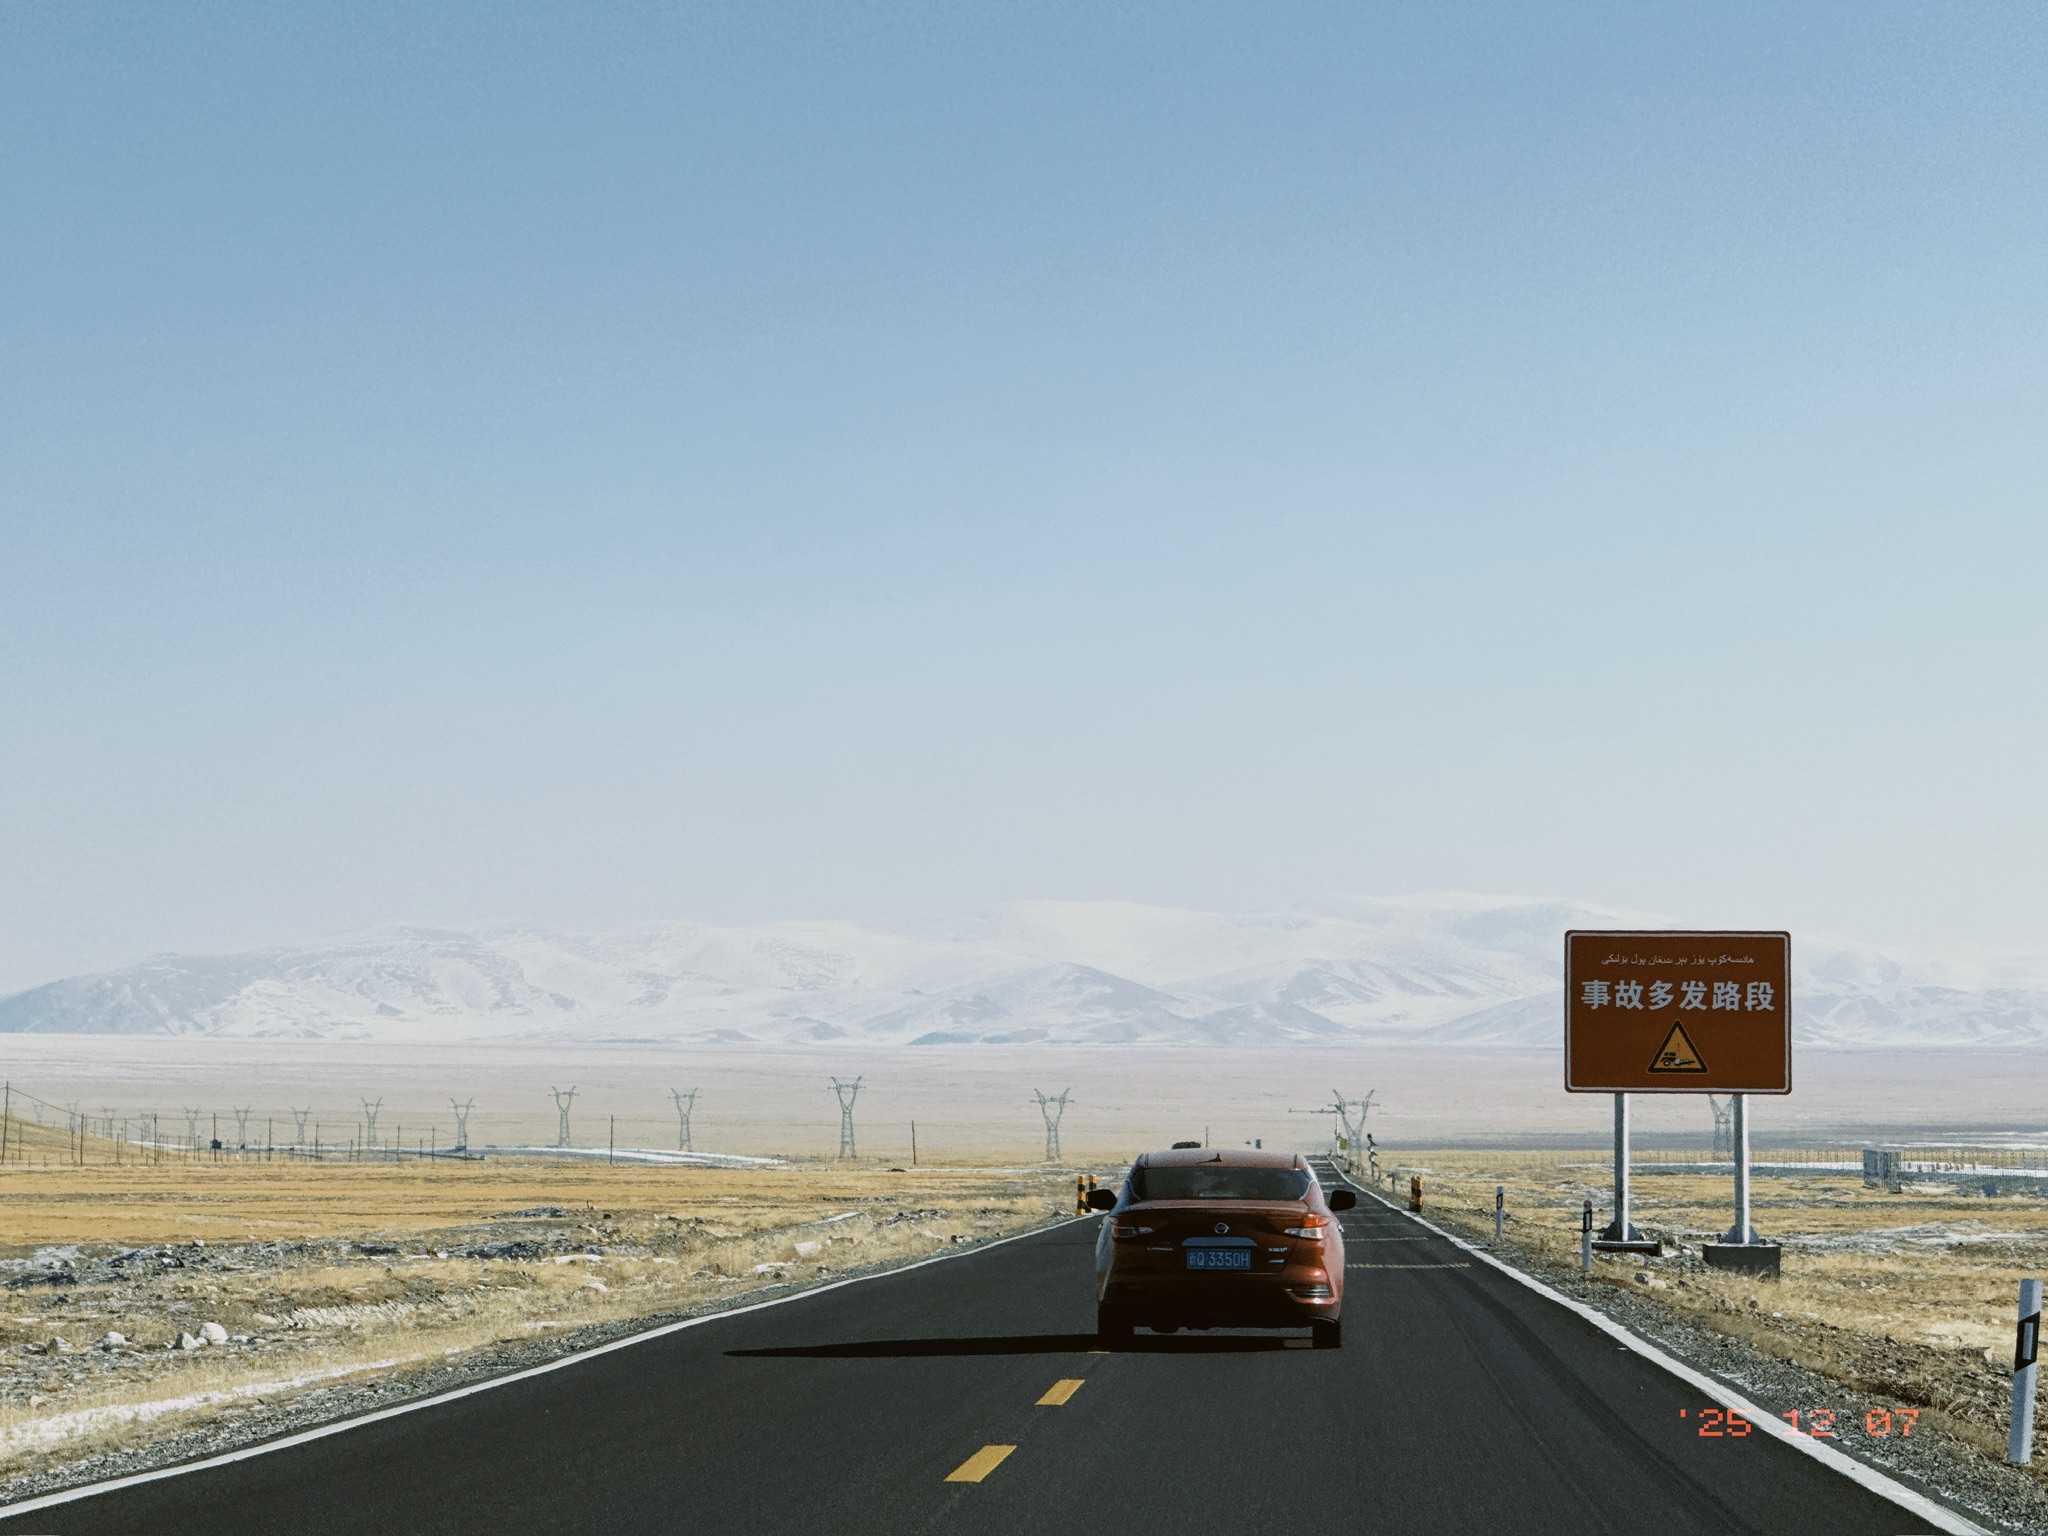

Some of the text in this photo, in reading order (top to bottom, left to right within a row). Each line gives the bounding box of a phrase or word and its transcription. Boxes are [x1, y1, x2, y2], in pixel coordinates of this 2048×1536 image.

[1580, 979, 1776, 1012] 事故多发路段
